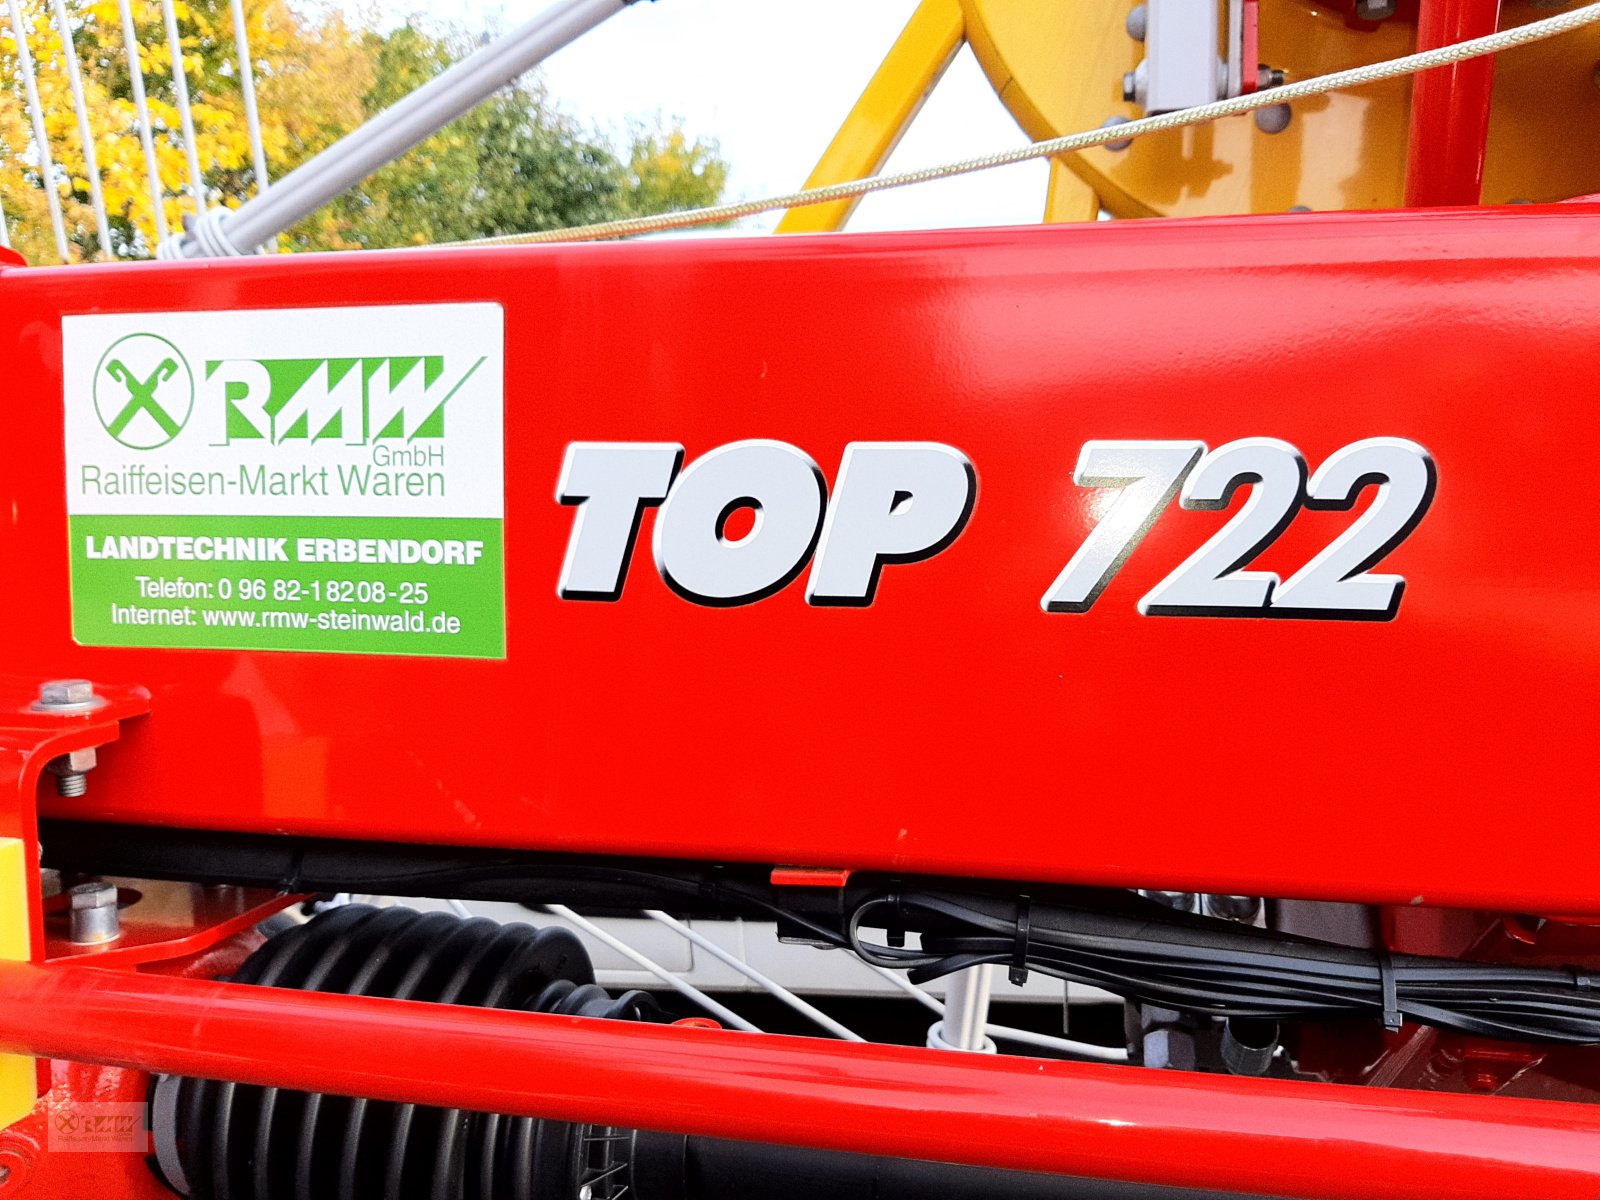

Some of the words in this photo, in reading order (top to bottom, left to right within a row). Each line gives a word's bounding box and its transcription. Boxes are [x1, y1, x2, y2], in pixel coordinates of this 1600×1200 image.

[205, 356, 487, 447] RMW
[372, 445, 445, 467] GmbH
[81, 464, 329, 495] Raiffeisen-Markt
[337, 465, 445, 497] Waren
[555, 439, 977, 607] TOP
[1041, 436, 1437, 621] 722
[86, 536, 289, 562] LANDTECHNIK
[297, 538, 484, 565] ERBENDORF
[135, 576, 214, 599] Telefon:
[218, 578, 232, 600] 0
[238, 578, 267, 601] 96
[112, 603, 197, 626] Internet:
[202, 607, 461, 634] www.rmw-steinwald.de
